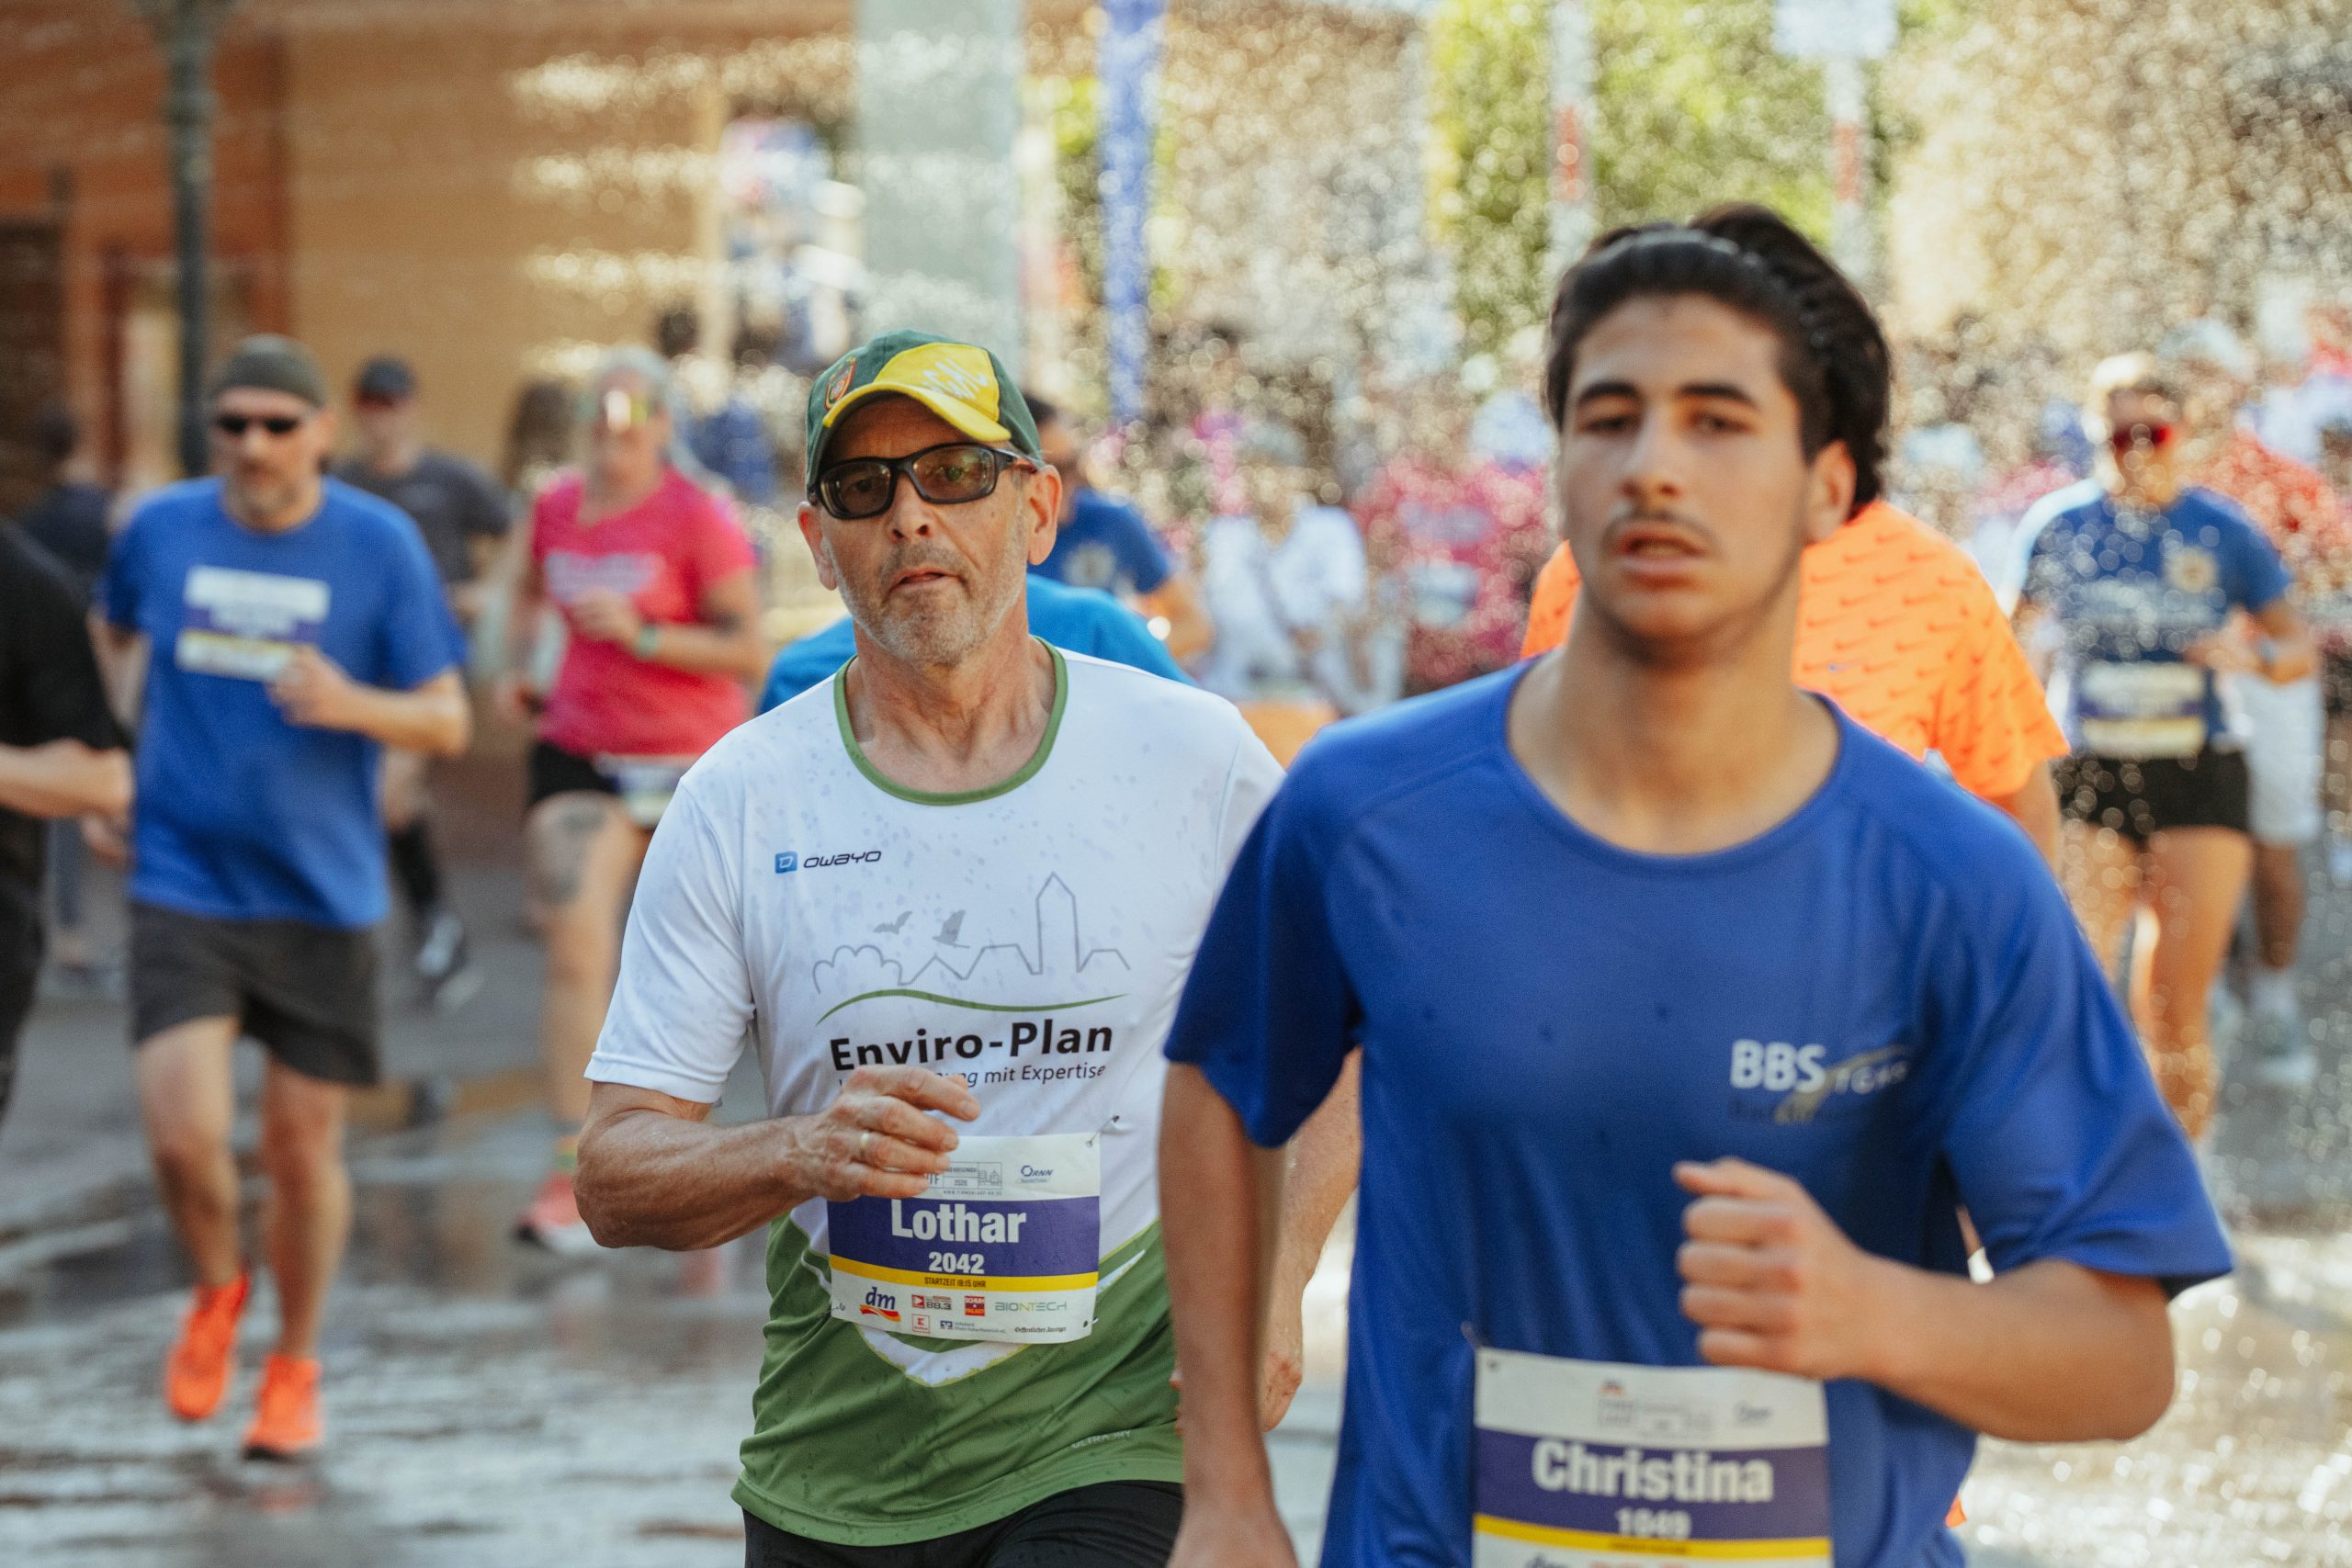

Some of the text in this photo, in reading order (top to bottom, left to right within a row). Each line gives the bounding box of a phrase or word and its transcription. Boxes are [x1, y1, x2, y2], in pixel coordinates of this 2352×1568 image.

[831, 1019, 1114, 1071] Enviro-Plan
[984, 1066, 1015, 1083] mit
[1021, 1062, 1106, 1085] Expertise
[1730, 1038, 1826, 1093] BBS
[891, 1199, 1027, 1243] Lothar
[928, 1251, 985, 1275] 2042
[924, 1277, 956, 1287] STARTZEIT
[865, 1286, 896, 1310] dm
[926, 1301, 952, 1311] 88.3
[1531, 1438, 1774, 1503] Christina
